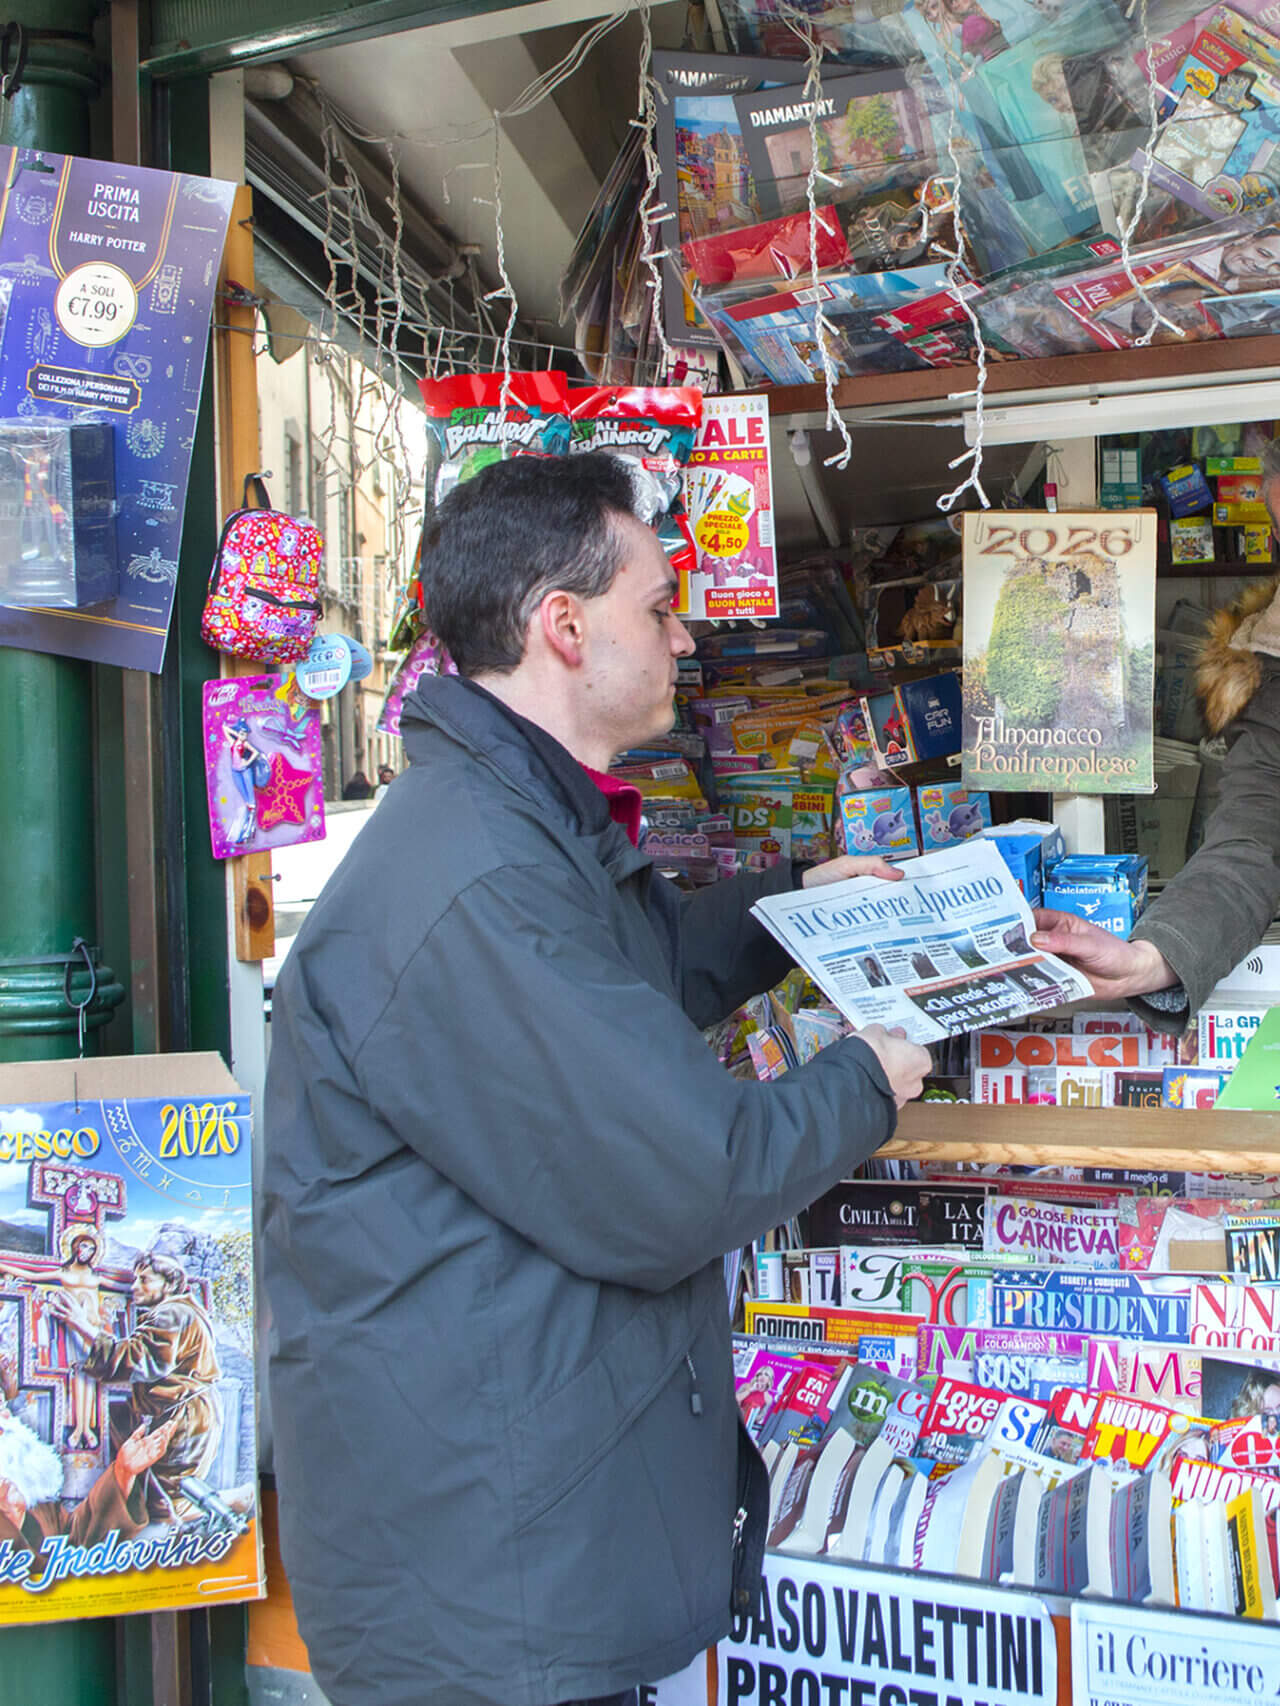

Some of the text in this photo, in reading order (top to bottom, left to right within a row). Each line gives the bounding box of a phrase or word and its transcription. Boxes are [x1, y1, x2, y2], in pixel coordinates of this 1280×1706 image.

[94, 183, 141, 204] PRIMA
[87, 201, 141, 223] USCITA
[69, 231, 147, 253] HARRY POTTER
[92, 284, 116, 299] SOLI
[723, 449, 765, 461] CARTE
[703, 520, 743, 530] SPECIALE
[707, 513, 740, 523] PREZZO
[979, 526, 1135, 557] 2026
[708, 597, 774, 608] BUON NATALE
[710, 590, 734, 600] Buon
[736, 590, 762, 600] gioco
[735, 606, 756, 616] tutti
[970, 715, 1103, 752] Almanacco
[967, 744, 1138, 785] Pontremolese
[788, 914, 811, 938] il
[810, 894, 912, 933] Corriere
[915, 874, 1004, 921] Apuano
[1215, 1016, 1232, 1028] La
[980, 1034, 1139, 1067] DOLCI
[160, 1101, 241, 1158] 2026
[839, 1202, 889, 1226] CIVILTÀ
[944, 1202, 971, 1220] LA
[1018, 1205, 1067, 1225] GOLOSE
[996, 1205, 1119, 1253] CARNEVA
[1098, 1398, 1168, 1436] NUOVO
[1093, 1422, 1159, 1467] TV
[21, 1527, 239, 1594] Indovino
[832, 1585, 1044, 1698] VALETTINI
[1096, 1631, 1117, 1674] il
[1126, 1634, 1266, 1696] Corriere
